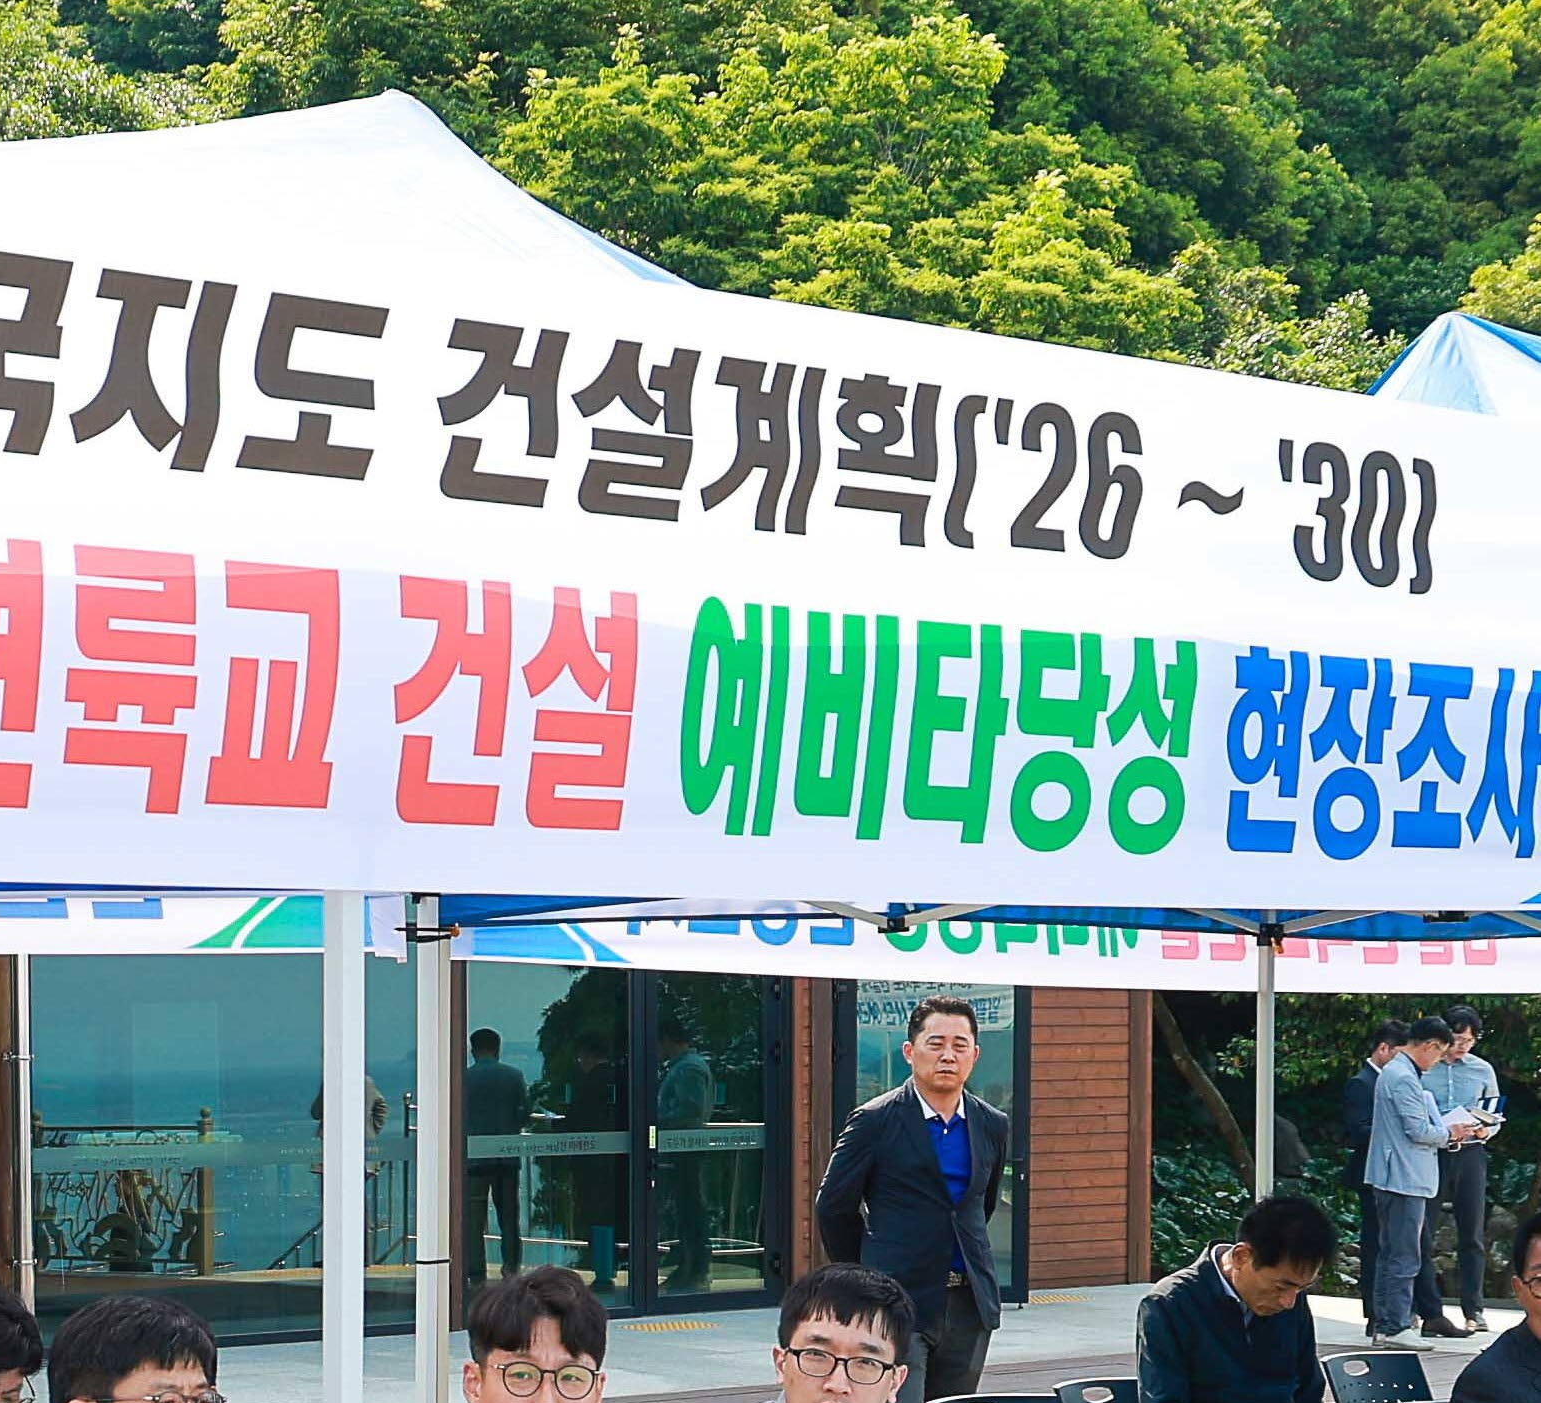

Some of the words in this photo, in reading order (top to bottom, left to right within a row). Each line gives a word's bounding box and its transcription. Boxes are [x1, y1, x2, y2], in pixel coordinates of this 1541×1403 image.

[438, 316, 1144, 560] 건설계획('26
[1278, 438, 1439, 595] '30)
[393, 573, 639, 832] 건설
[681, 596, 1198, 857] 예비타당성
